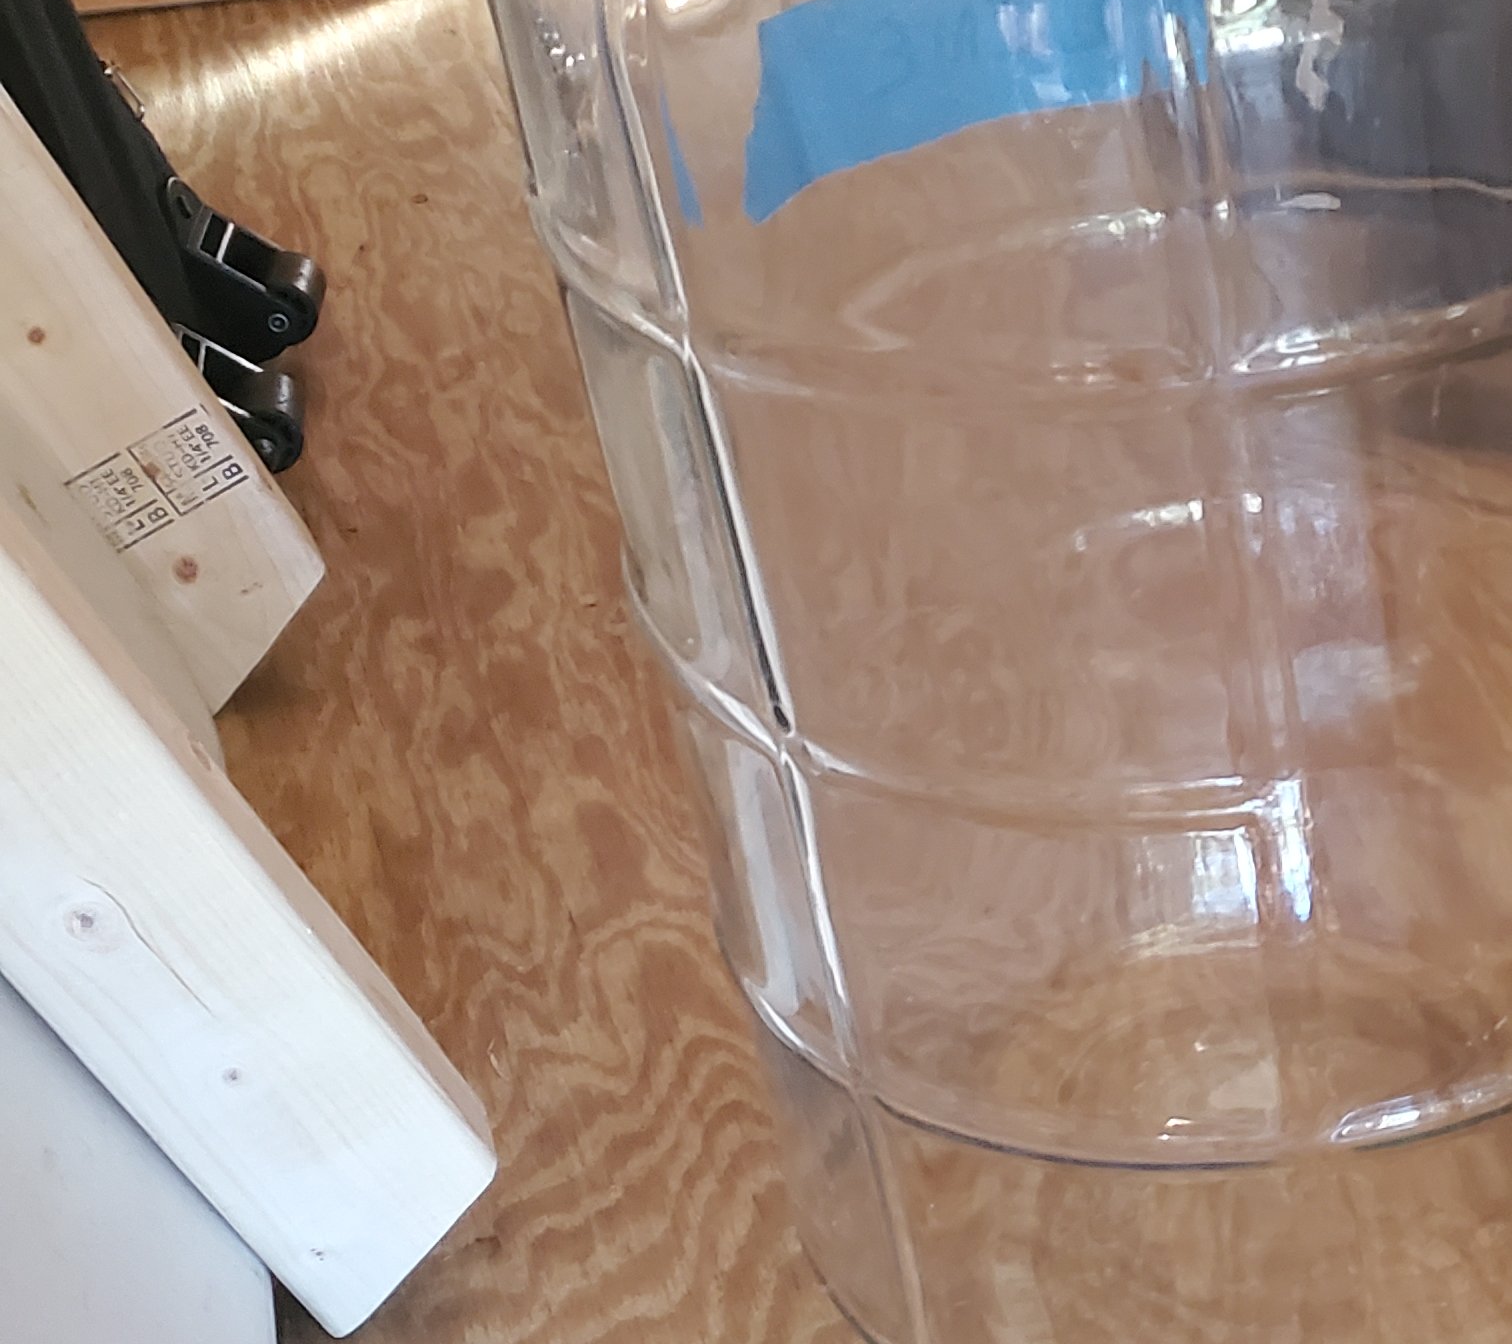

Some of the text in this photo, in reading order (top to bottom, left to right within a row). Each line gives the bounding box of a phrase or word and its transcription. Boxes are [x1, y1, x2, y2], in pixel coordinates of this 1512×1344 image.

[194, 423, 219, 449] 708
[99, 468, 120, 486] EE
[120, 467, 144, 492] 708
